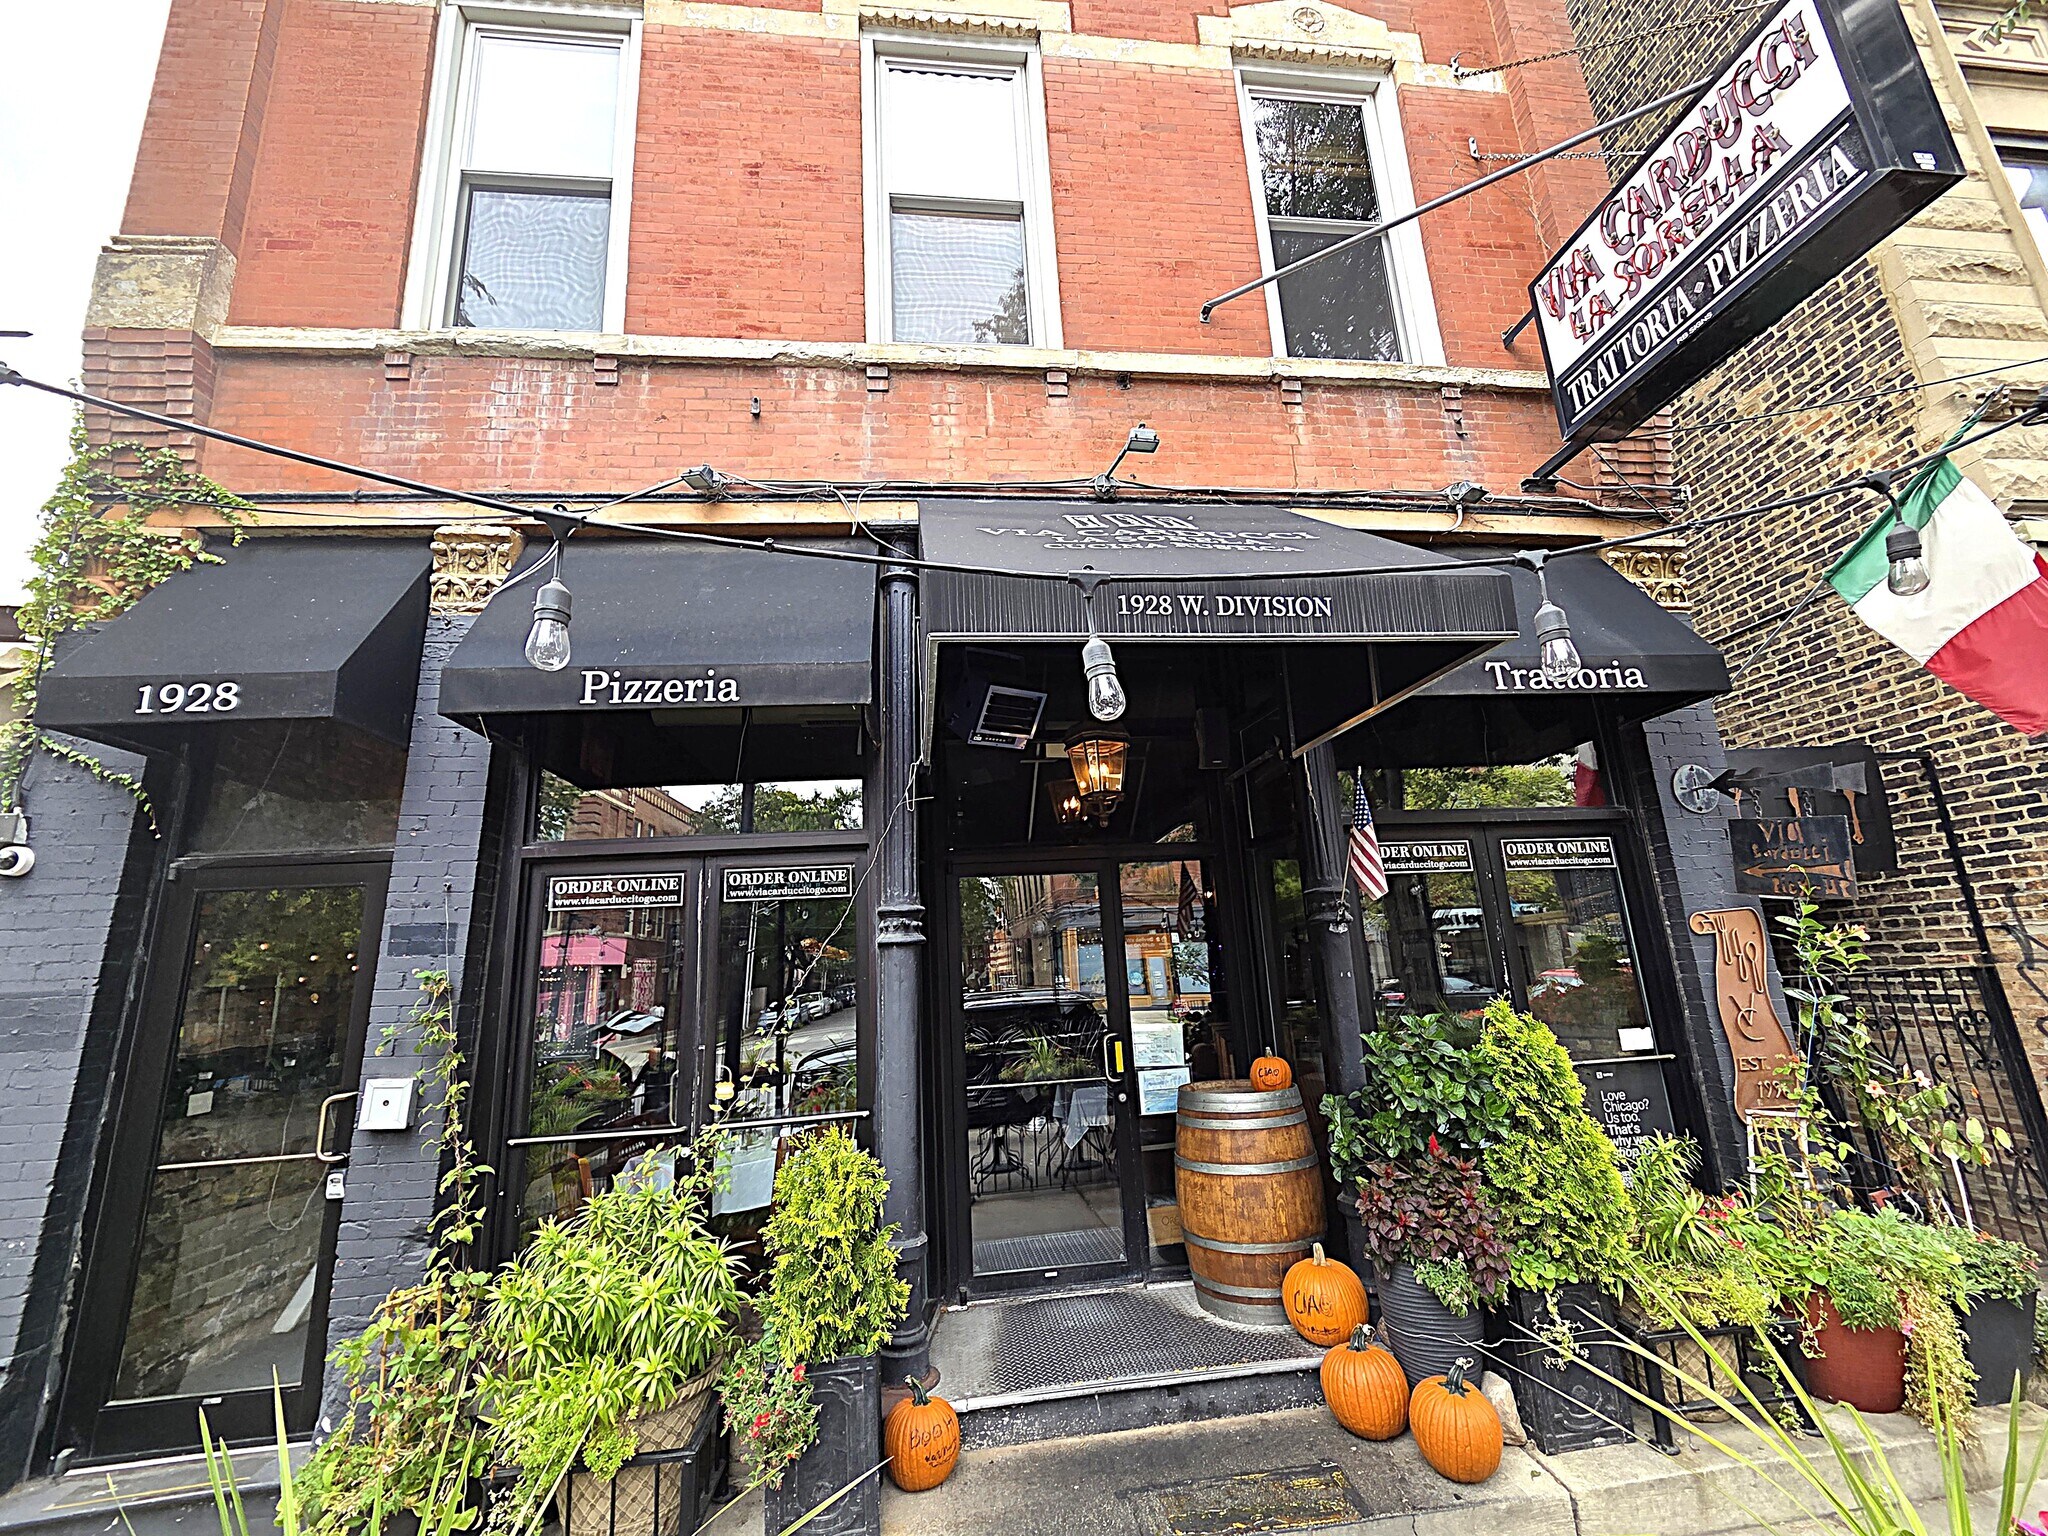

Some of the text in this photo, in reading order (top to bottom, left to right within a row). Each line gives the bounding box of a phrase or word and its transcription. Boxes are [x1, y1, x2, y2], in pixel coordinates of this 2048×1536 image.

[1536, 10, 1819, 321] VIA CARDUCCI
[1569, 122, 1793, 345] LA SORELLA
[1567, 144, 1860, 414] TRATTORIA PIZZERIA
[976, 527, 1321, 540] VIA CARDUCCI
[1052, 536, 1109, 544] LA
[1043, 542, 1168, 550] CUCINA
[1117, 594, 1332, 617] 1928 W. DIVISION
[578, 669, 741, 704] Pizzeria
[135, 682, 240, 714] 1928
[1379, 843, 1468, 858] DER ONLINE
[1506, 841, 1610, 855] ORDER ONLINE
[1382, 859, 1469, 871] .viacarduccitogo.com
[1508, 856, 1612, 867] www.viacarduccitogo.com
[727, 869, 848, 886] ORDER ONLINE
[555, 877, 679, 895] ORDER ONLINE
[729, 885, 847, 898] www.viacarduccitogo.com
[555, 893, 678, 906] www.viacarduccitogo.com
[1738, 1056, 1771, 1071] EST.
[1600, 1090, 1626, 1102] Love
[1757, 1080, 1789, 1099] 199
[1603, 1098, 1650, 1113] Chicago?
[1604, 1112, 1641, 1124] Us too.
[1606, 1123, 1641, 1136] That's
[1611, 1135, 1632, 1148] why
[1618, 1146, 1641, 1160] hop
